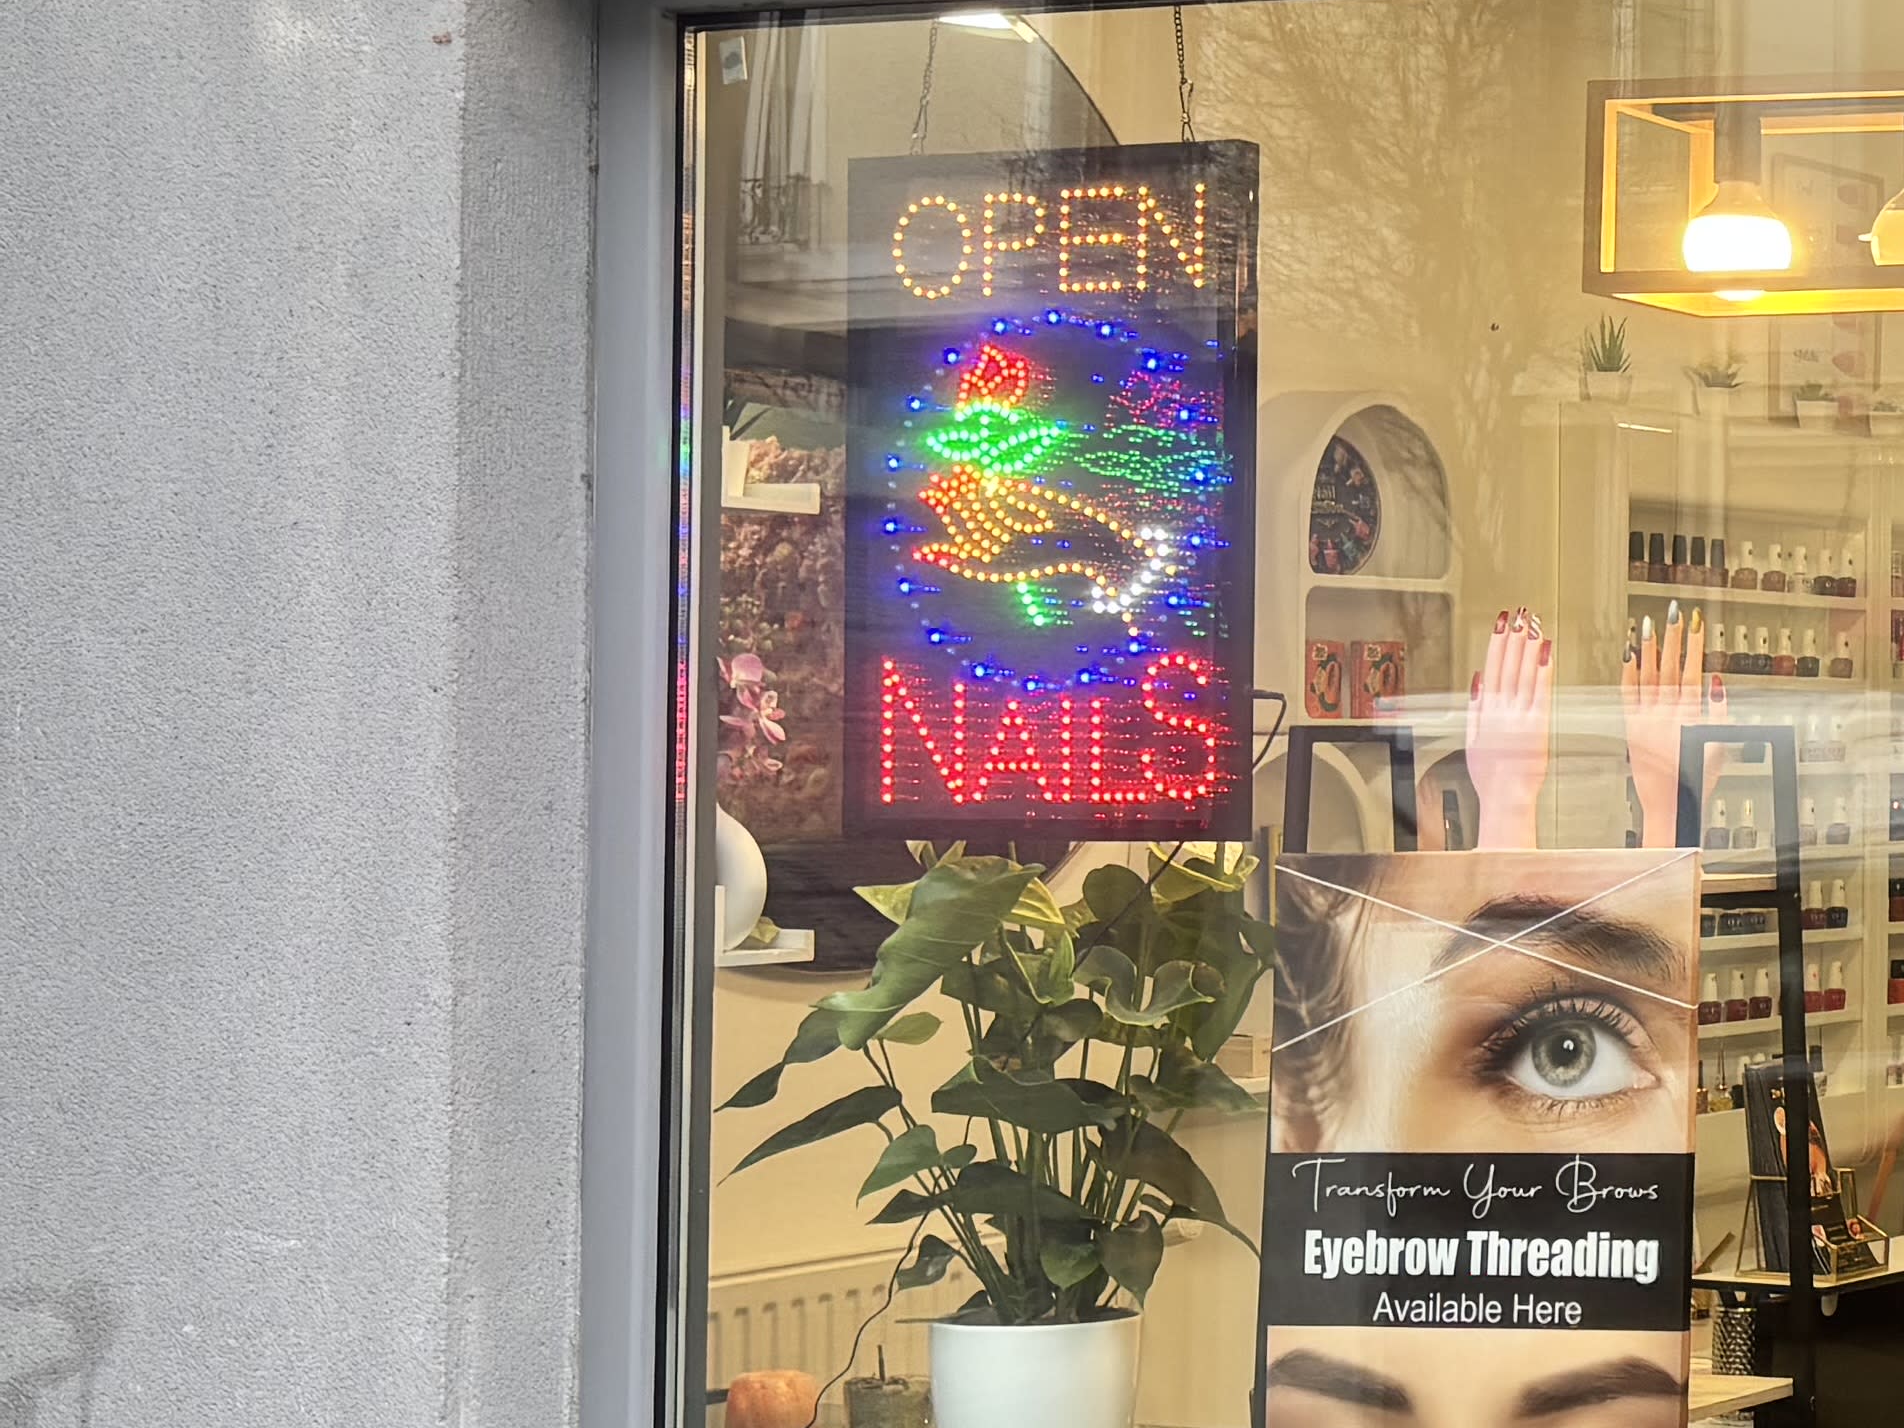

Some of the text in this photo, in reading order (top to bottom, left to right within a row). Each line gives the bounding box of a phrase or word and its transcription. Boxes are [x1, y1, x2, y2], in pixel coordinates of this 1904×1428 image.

[893, 182, 1205, 300] OPEN
[881, 655, 1217, 804] NAILS
[1292, 1154, 1658, 1219] Transform Your Brows
[1304, 1229, 1660, 1284] Eyebrow Threading
[1372, 1292, 1582, 1325] Available Here
